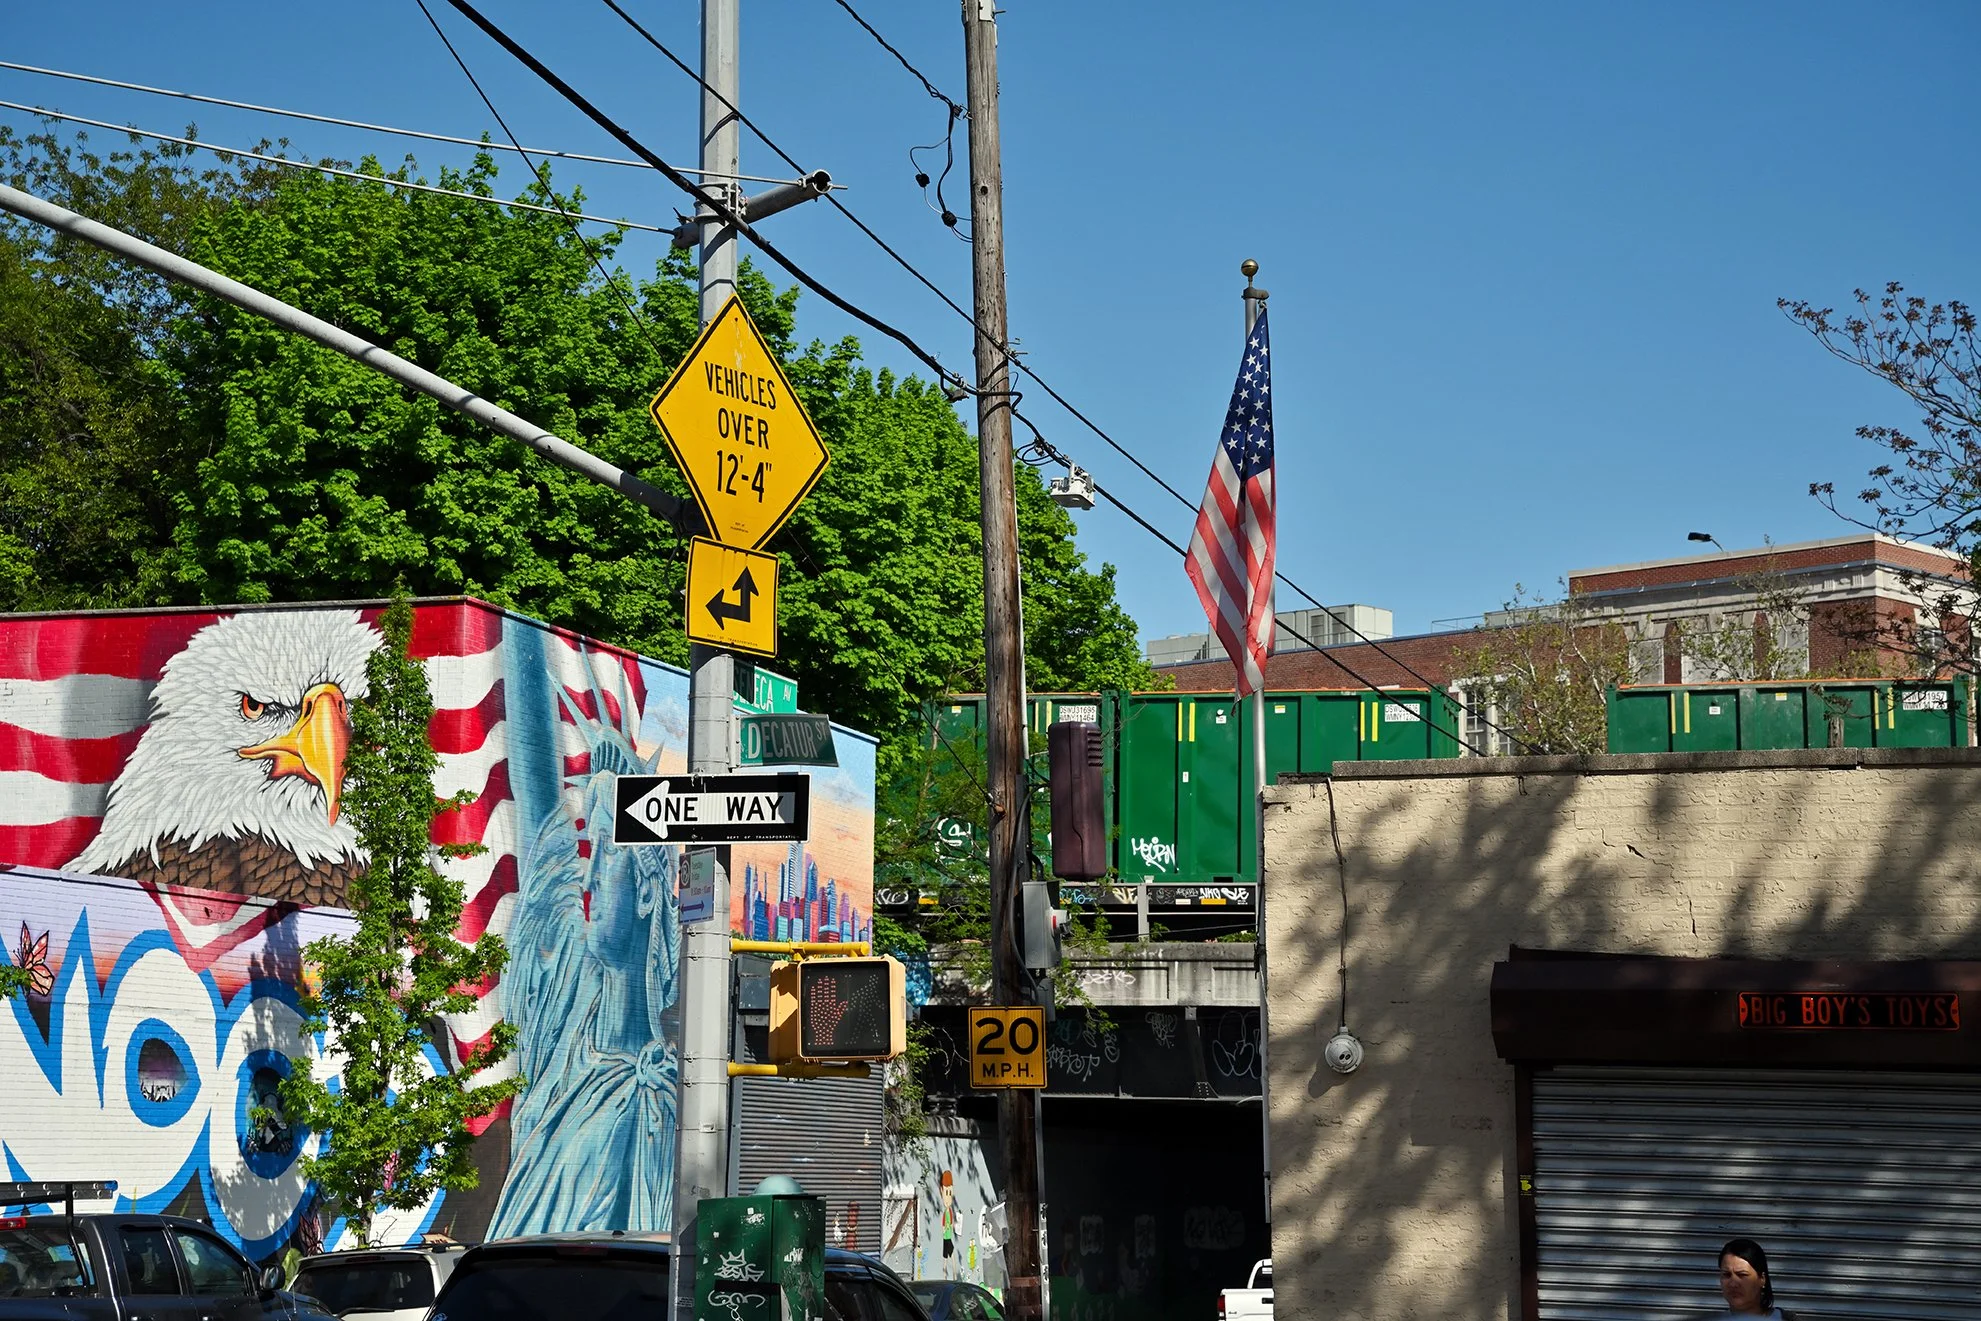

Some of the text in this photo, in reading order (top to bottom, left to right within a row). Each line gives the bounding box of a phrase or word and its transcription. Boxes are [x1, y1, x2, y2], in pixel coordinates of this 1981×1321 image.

[704, 361, 776, 410] VEHICLES
[718, 407, 769, 450] OVER
[748, 721, 828, 759] DECATUR ST
[646, 796, 784, 823] ONE WAY
[1751, 996, 1948, 1025] BIG BOY'S TOYS
[976, 1017, 1039, 1056] 20
[982, 1062, 1034, 1078] M.P.H.
